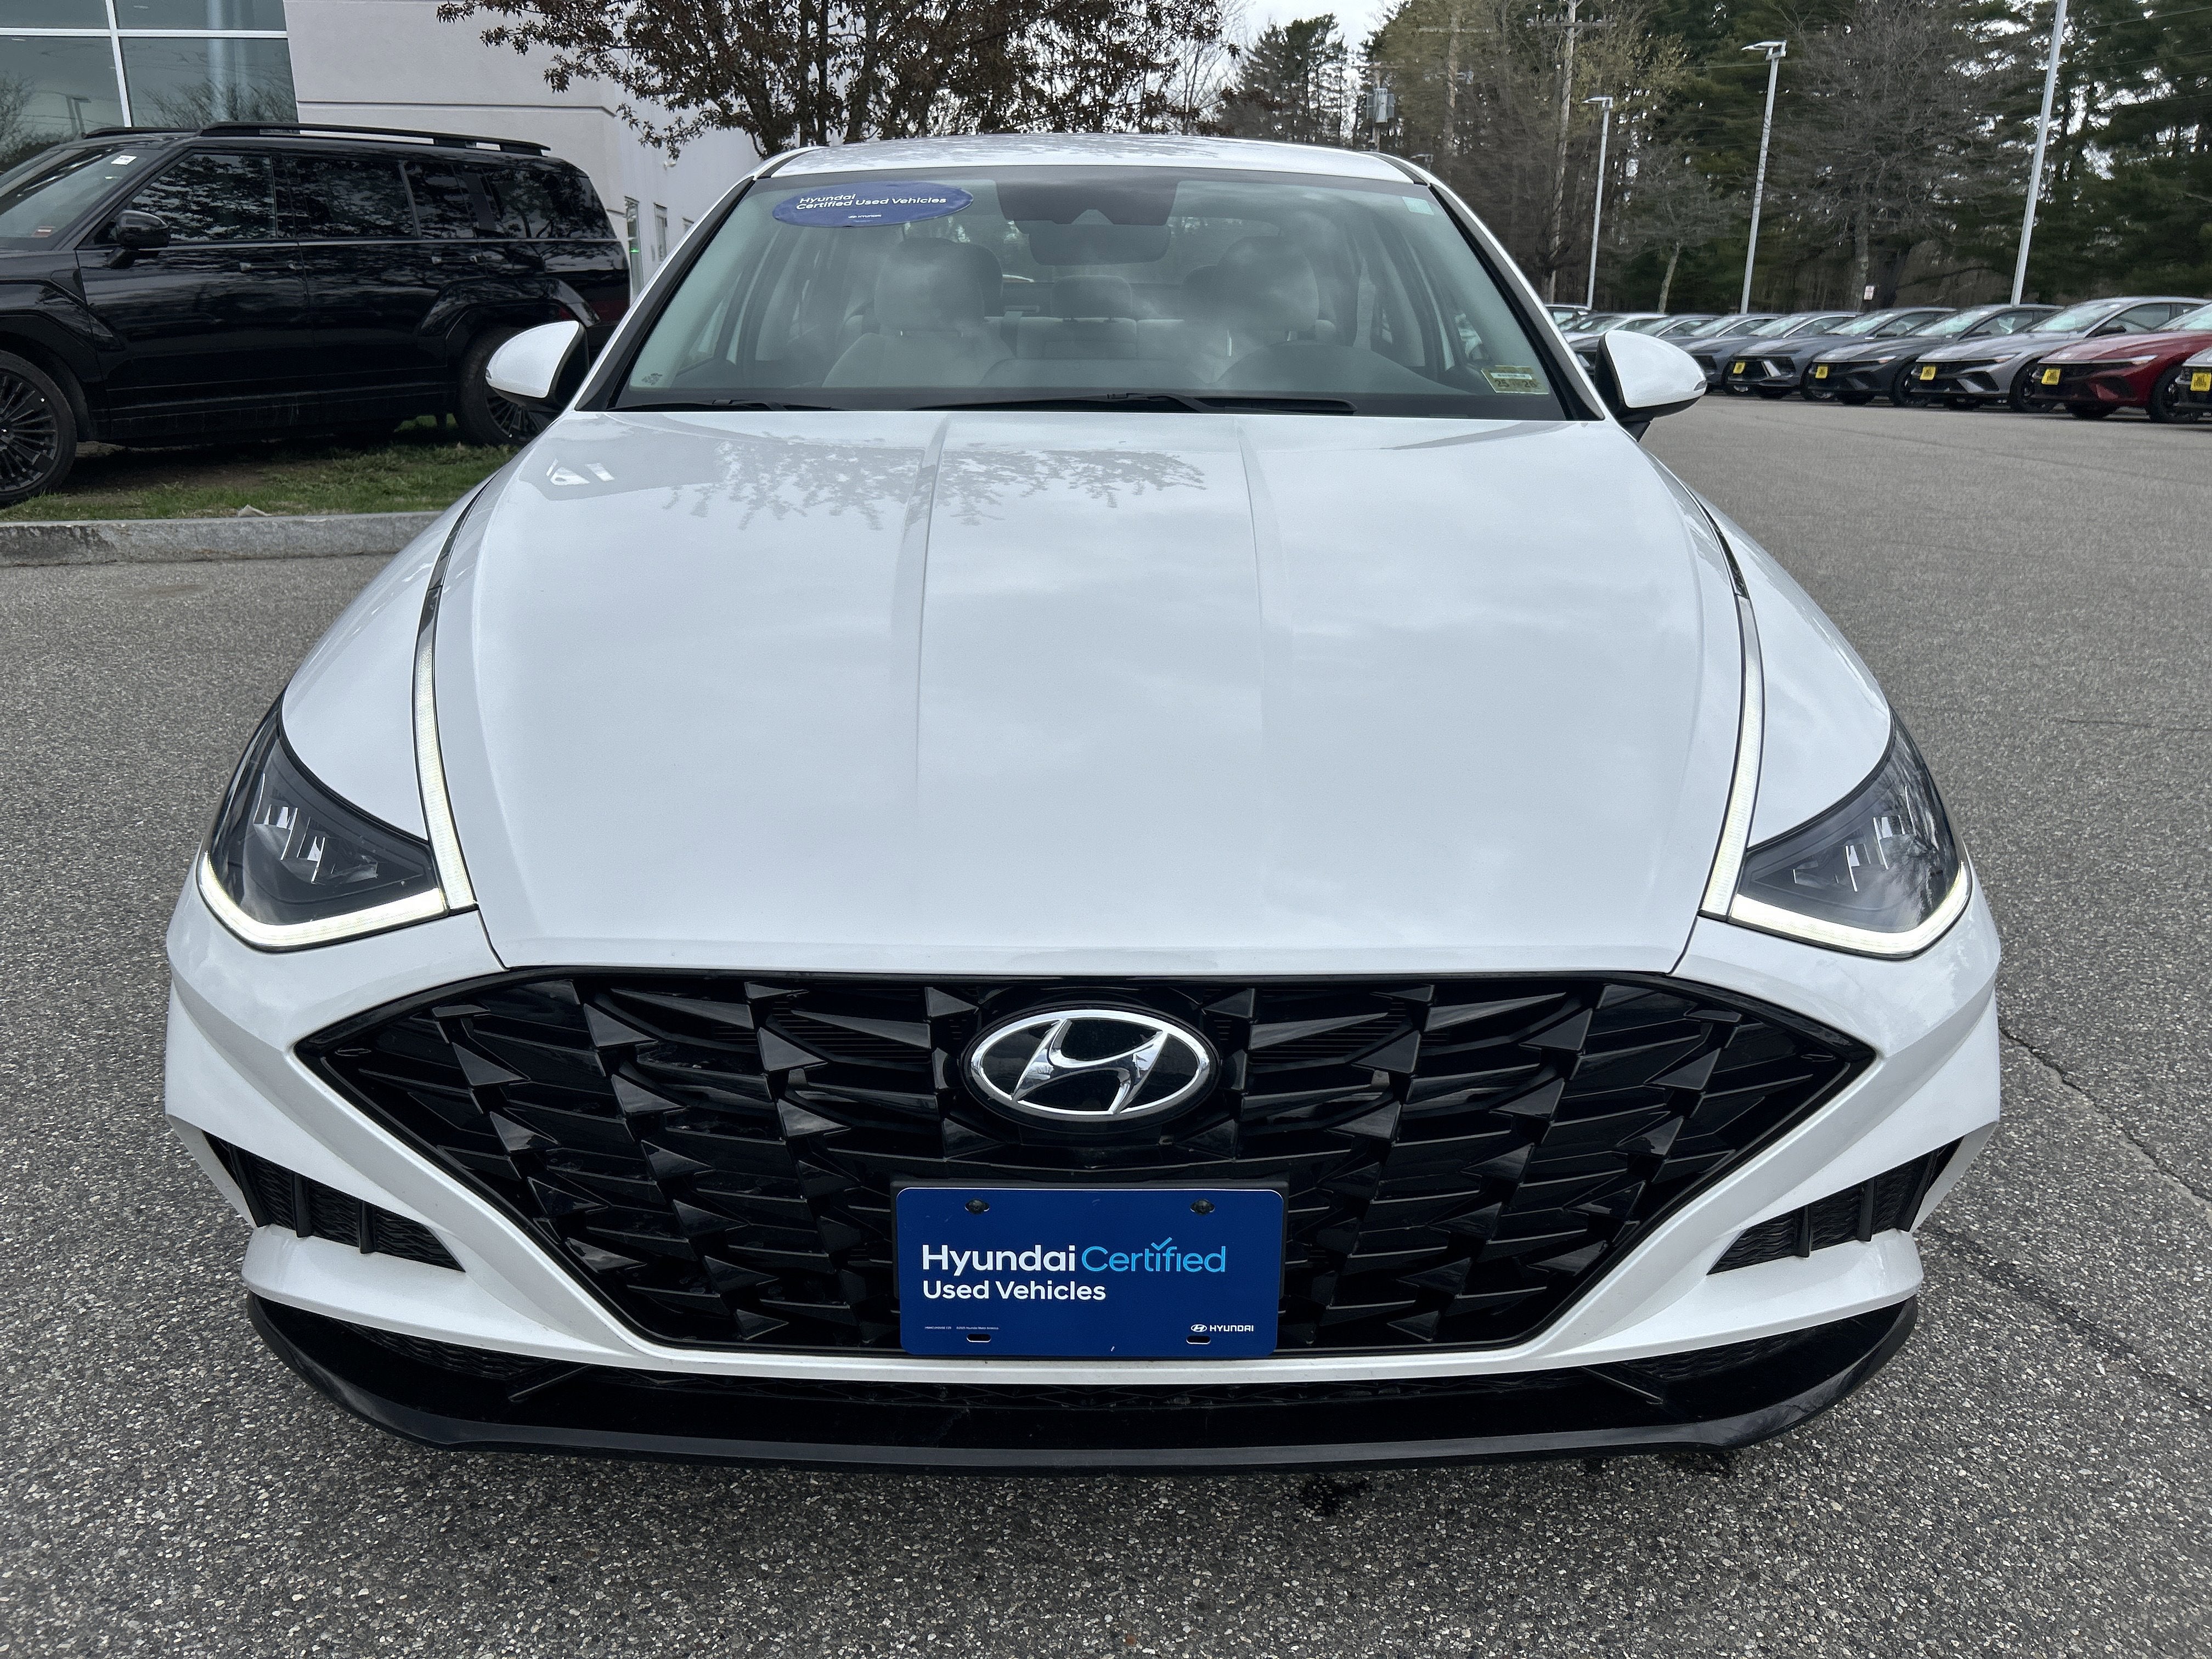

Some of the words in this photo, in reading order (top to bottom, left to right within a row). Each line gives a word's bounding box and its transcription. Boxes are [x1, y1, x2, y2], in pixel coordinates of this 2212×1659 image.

[796, 200, 853, 210] Certified
[799, 193, 856, 204] Hyundai
[922, 1244, 1075, 1277] Hyundai
[1081, 1237, 1226, 1273] Certified
[923, 1280, 989, 1300] Used
[995, 1280, 1107, 1300] Vehicles
